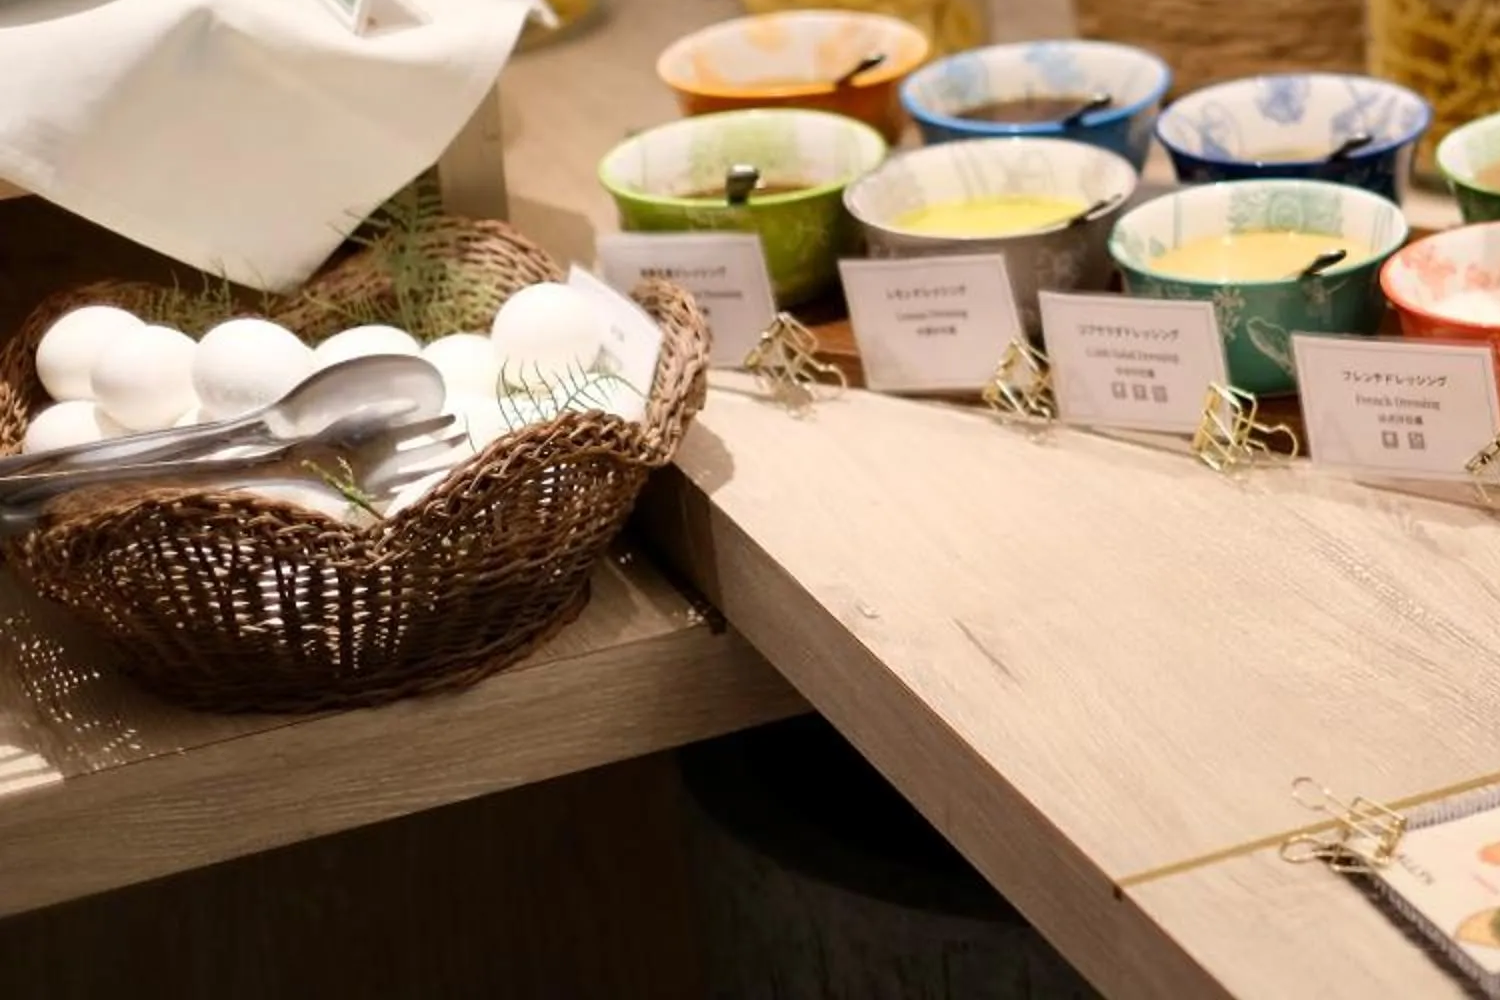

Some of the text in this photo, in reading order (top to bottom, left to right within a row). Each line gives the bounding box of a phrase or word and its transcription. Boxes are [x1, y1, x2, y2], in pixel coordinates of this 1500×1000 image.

[1341, 370, 1448, 388] フレンチドレッシング
